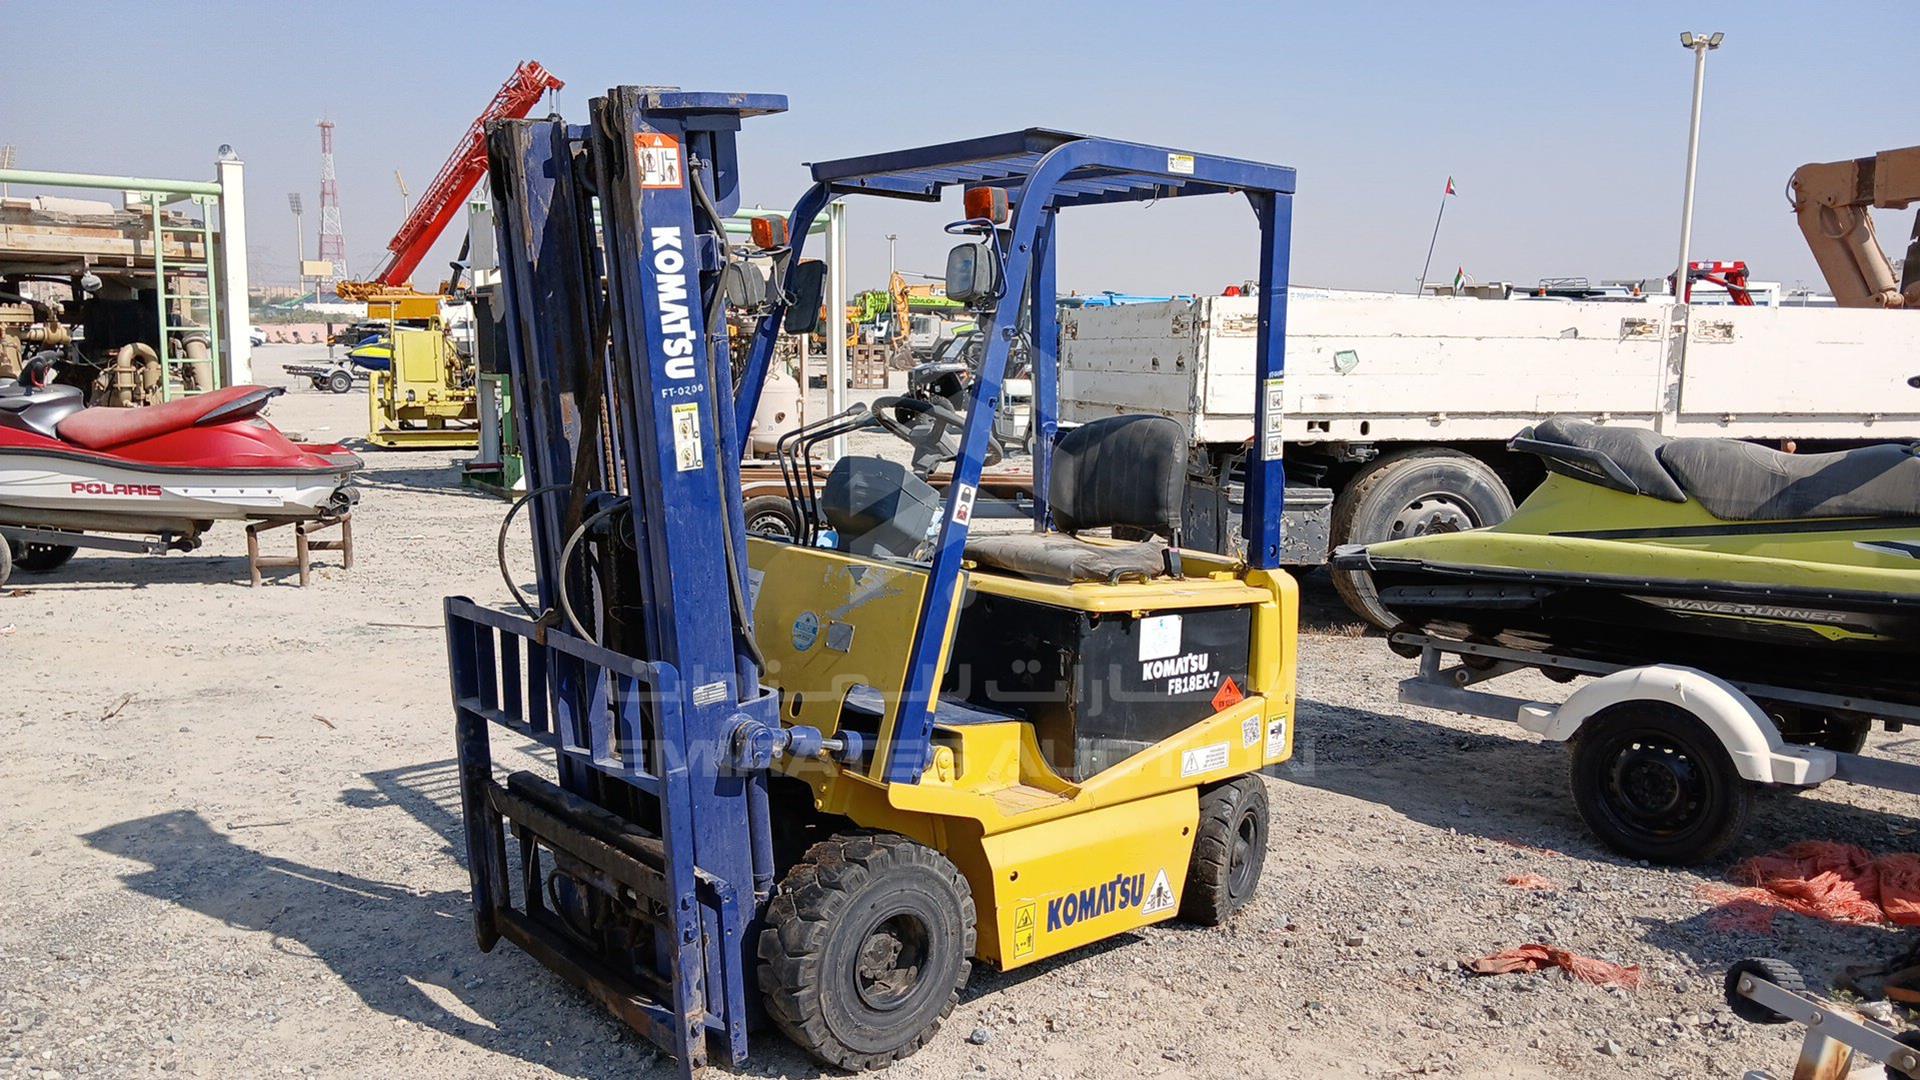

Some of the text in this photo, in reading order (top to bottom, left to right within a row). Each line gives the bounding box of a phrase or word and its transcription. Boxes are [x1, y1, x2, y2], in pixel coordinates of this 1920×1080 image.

[650, 226, 697, 380] KOMATSU
[661, 383, 704, 399] FT-0200
[71, 482, 162, 496] POLARIS
[1666, 598, 1847, 623] WAVERUNNER
[1141, 652, 1209, 681] KOMATSU
[1167, 671, 1220, 696] FB18EX-7
[1047, 872, 1145, 933] KOMATSU
